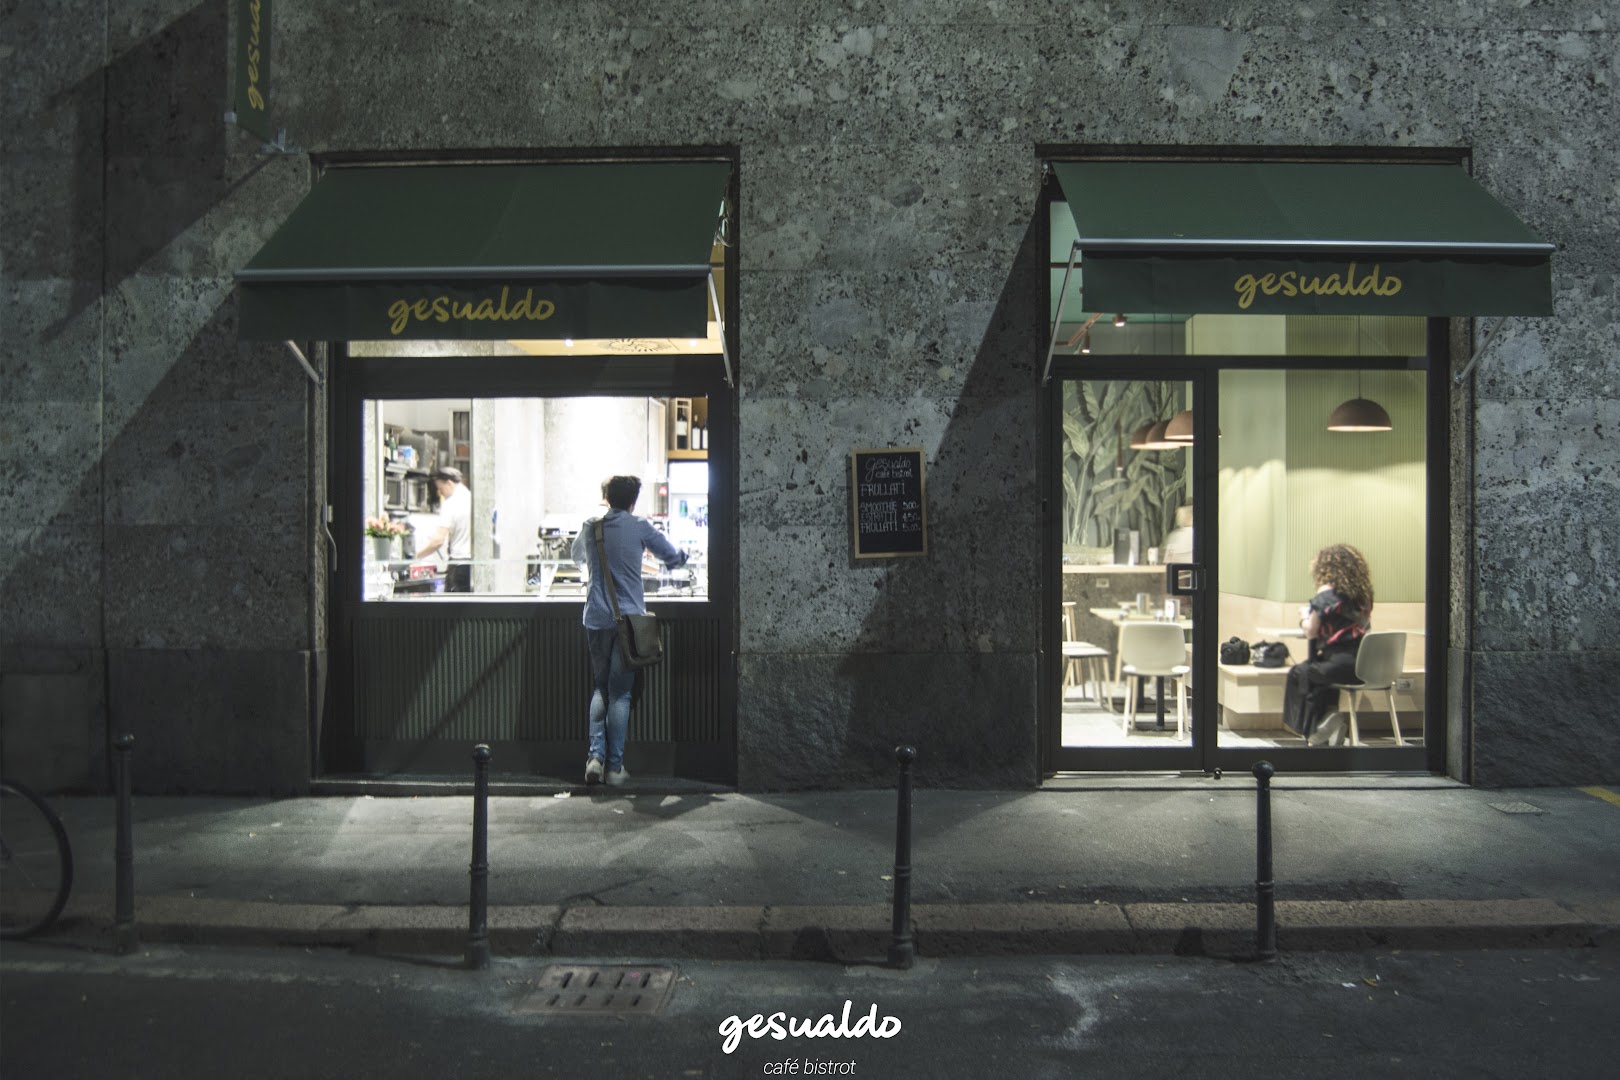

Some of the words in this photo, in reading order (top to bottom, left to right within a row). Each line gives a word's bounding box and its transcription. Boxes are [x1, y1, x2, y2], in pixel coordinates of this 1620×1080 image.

[1234, 261, 1402, 309] gesualdo
[388, 285, 555, 335] gesualdo
[859, 481, 905, 497] FRULLATI
